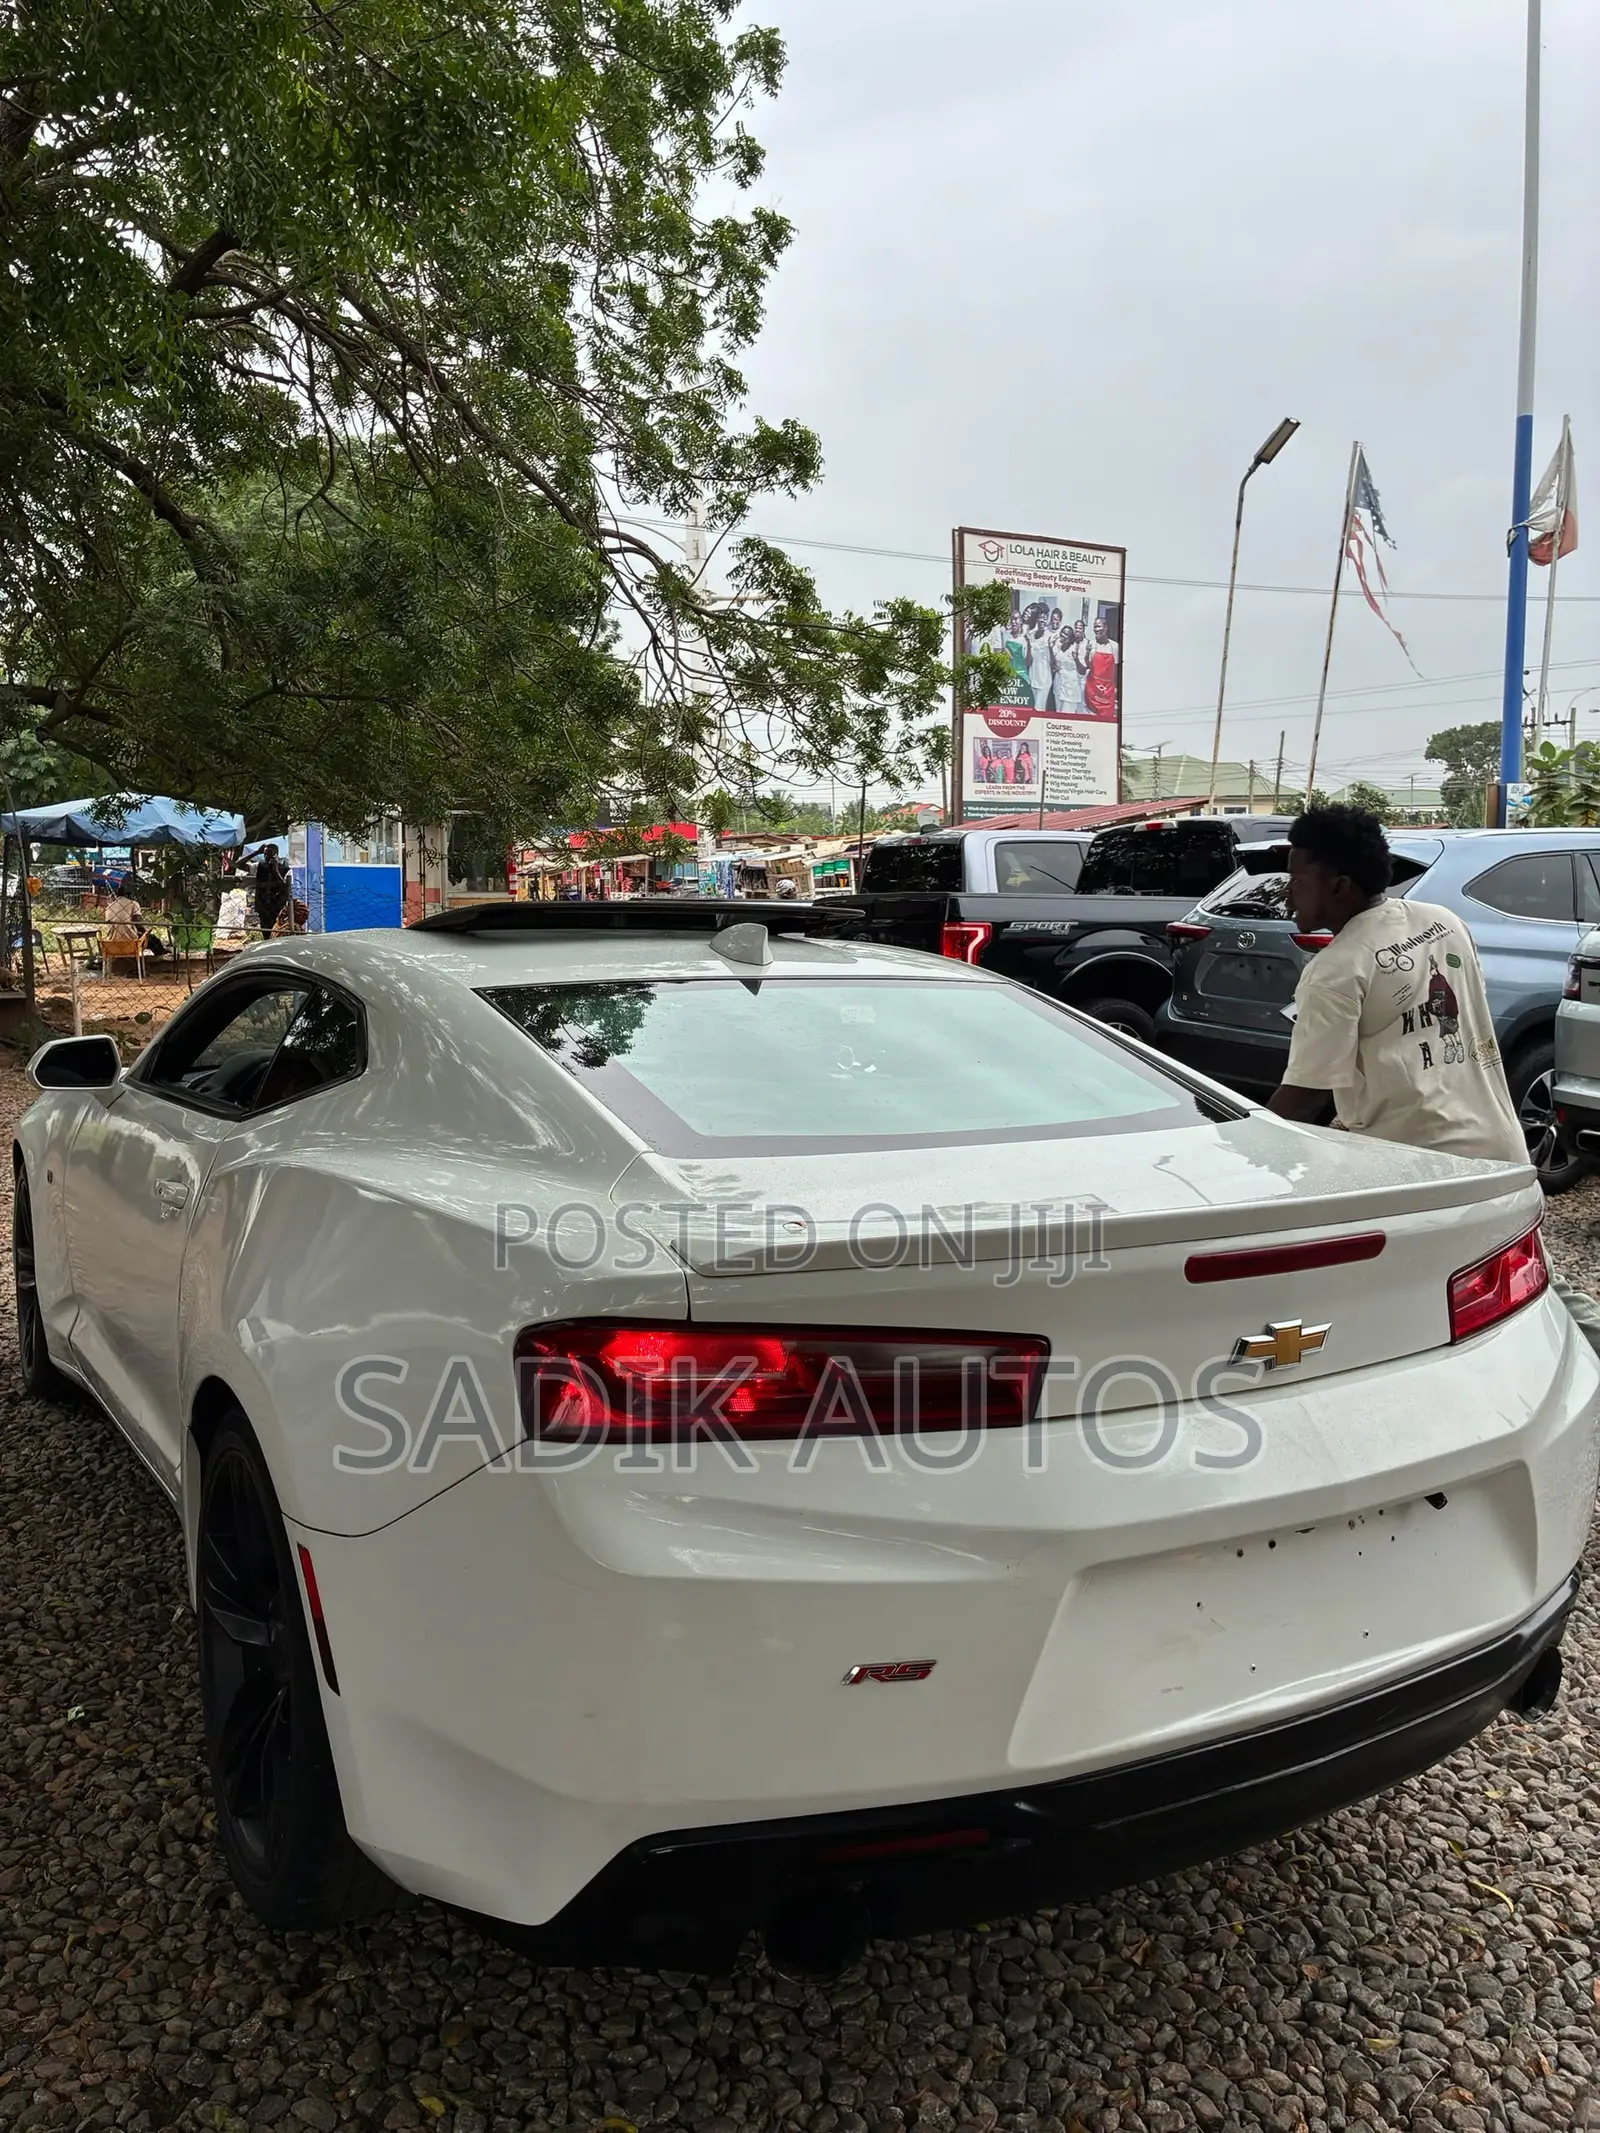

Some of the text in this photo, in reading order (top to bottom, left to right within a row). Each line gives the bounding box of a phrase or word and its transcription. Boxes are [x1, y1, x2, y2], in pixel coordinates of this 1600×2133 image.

[1010, 544, 1107, 565] LOLA HAIR & BEAUTY
[1035, 559, 1078, 572] COLLEGE
[995, 567, 1091, 585] Redefining Beauty Education
[1017, 577, 1052, 589] Innovative
[1054, 582, 1086, 593] Programs
[999, 695, 1030, 705] ENJOY
[998, 709, 1017, 718] 20%
[988, 718, 1027, 727] DISCOUNT!
[1003, 921, 1078, 933] SPORT
[841, 1659, 937, 1686] RS
